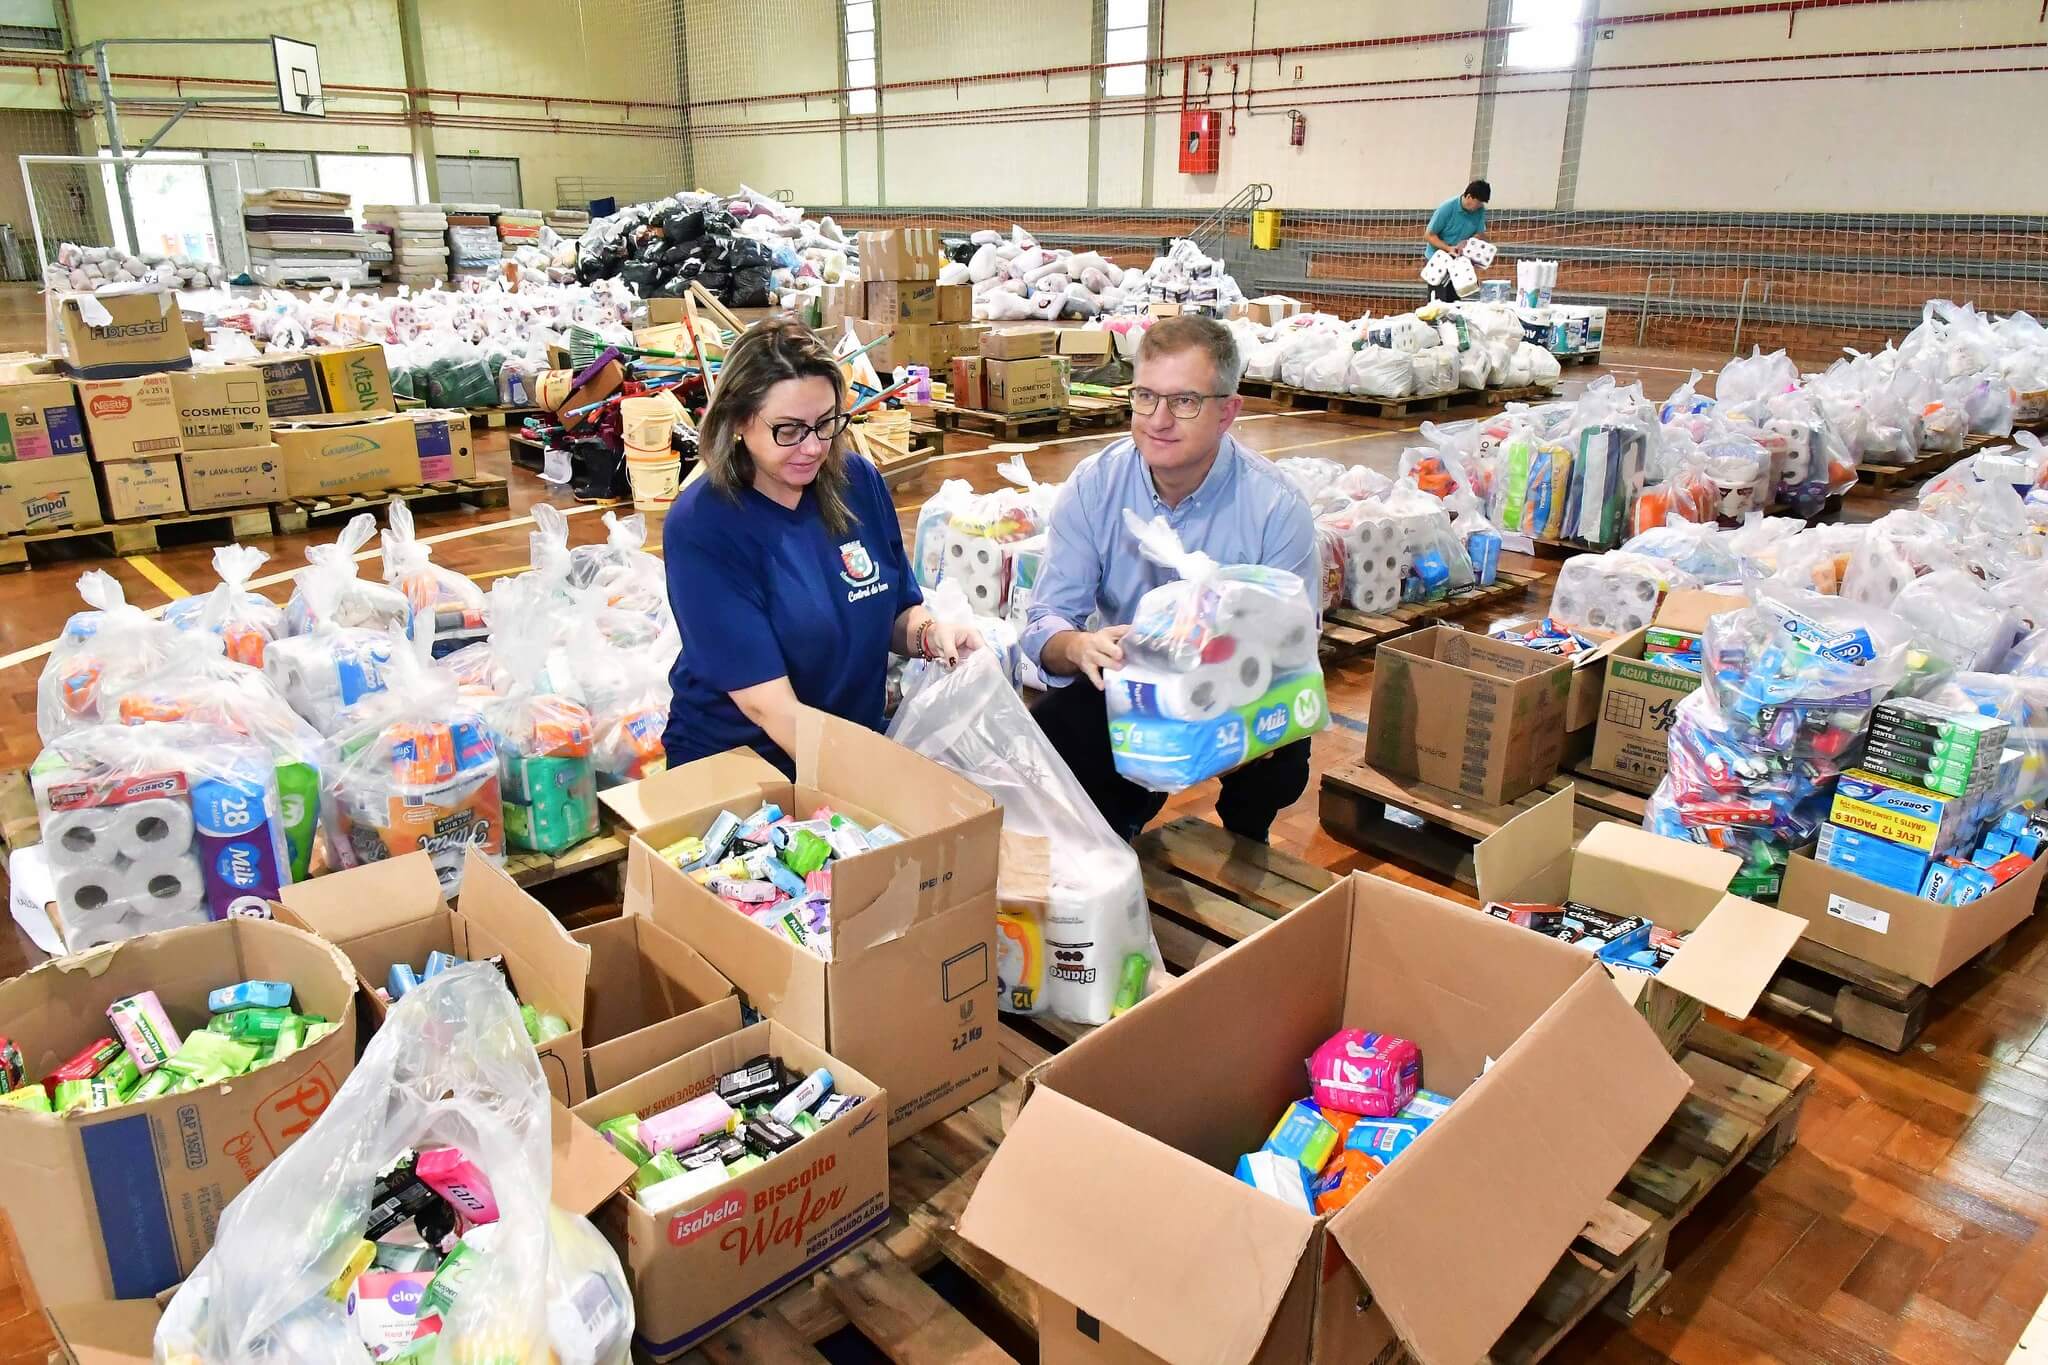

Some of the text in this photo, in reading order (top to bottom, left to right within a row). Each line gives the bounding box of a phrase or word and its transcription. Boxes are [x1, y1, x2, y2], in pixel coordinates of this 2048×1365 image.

[91, 317, 168, 341] Florestal
[181, 405, 261, 418] COSMÉTICO
[26, 496, 68, 519] Limpol
[1619, 664, 1648, 681] ÁGUA
[1255, 709, 1288, 736] Mili
[1876, 712, 1900, 723] DENTES
[1215, 722, 1241, 749] 32
[1872, 729, 1896, 740] DENTES
[1868, 745, 1892, 757] DENTES
[1863, 761, 1888, 773] DENTES
[127, 778, 174, 795] SORRISO
[220, 798, 249, 828] 28
[1887, 797, 1932, 814] SORRISO
[1835, 811, 1922, 844] LEVE 12 PAGUE 9
[228, 846, 254, 887] Mili
[1567, 910, 1614, 929] closeup
[1050, 968, 1096, 984] Bianco
[952, 1025, 982, 1052] 2,2 Kg
[675, 1073, 716, 1102] ESTOQUE
[653, 1093, 677, 1112] MAIS
[753, 1152, 836, 1215] Biscoito
[676, 1197, 742, 1240] isabela
[719, 1184, 848, 1266] Wafer
[806, 1237, 828, 1257] PESO
